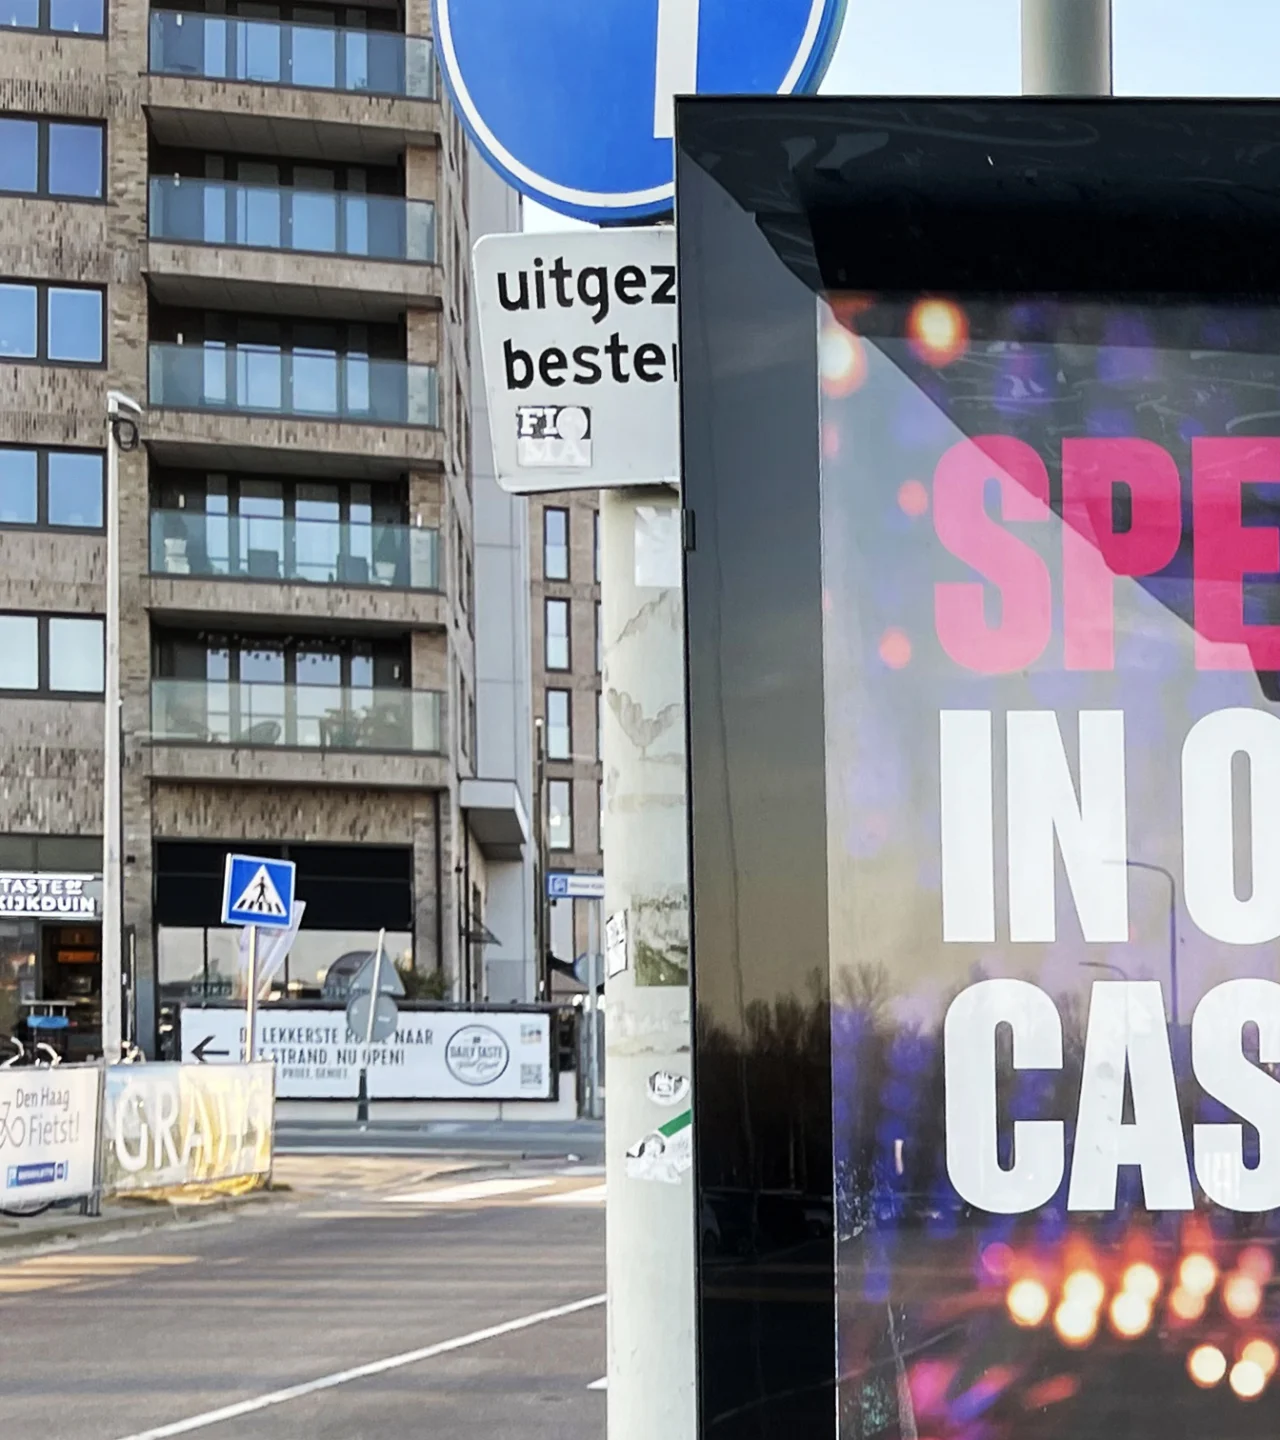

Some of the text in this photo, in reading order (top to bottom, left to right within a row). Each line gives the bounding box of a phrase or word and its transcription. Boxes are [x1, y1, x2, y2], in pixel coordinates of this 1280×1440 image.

[503, 332, 678, 391] beste
[939, 708, 1129, 943] IN
[2, 879, 63, 894] TASTE
[262, 1027, 338, 1044] LEKKERSTE
[394, 1028, 433, 1045] NAAR
[337, 1049, 357, 1065] NU
[16, 1086, 70, 1111] Den Haag
[29, 1111, 80, 1145] Fietst!
